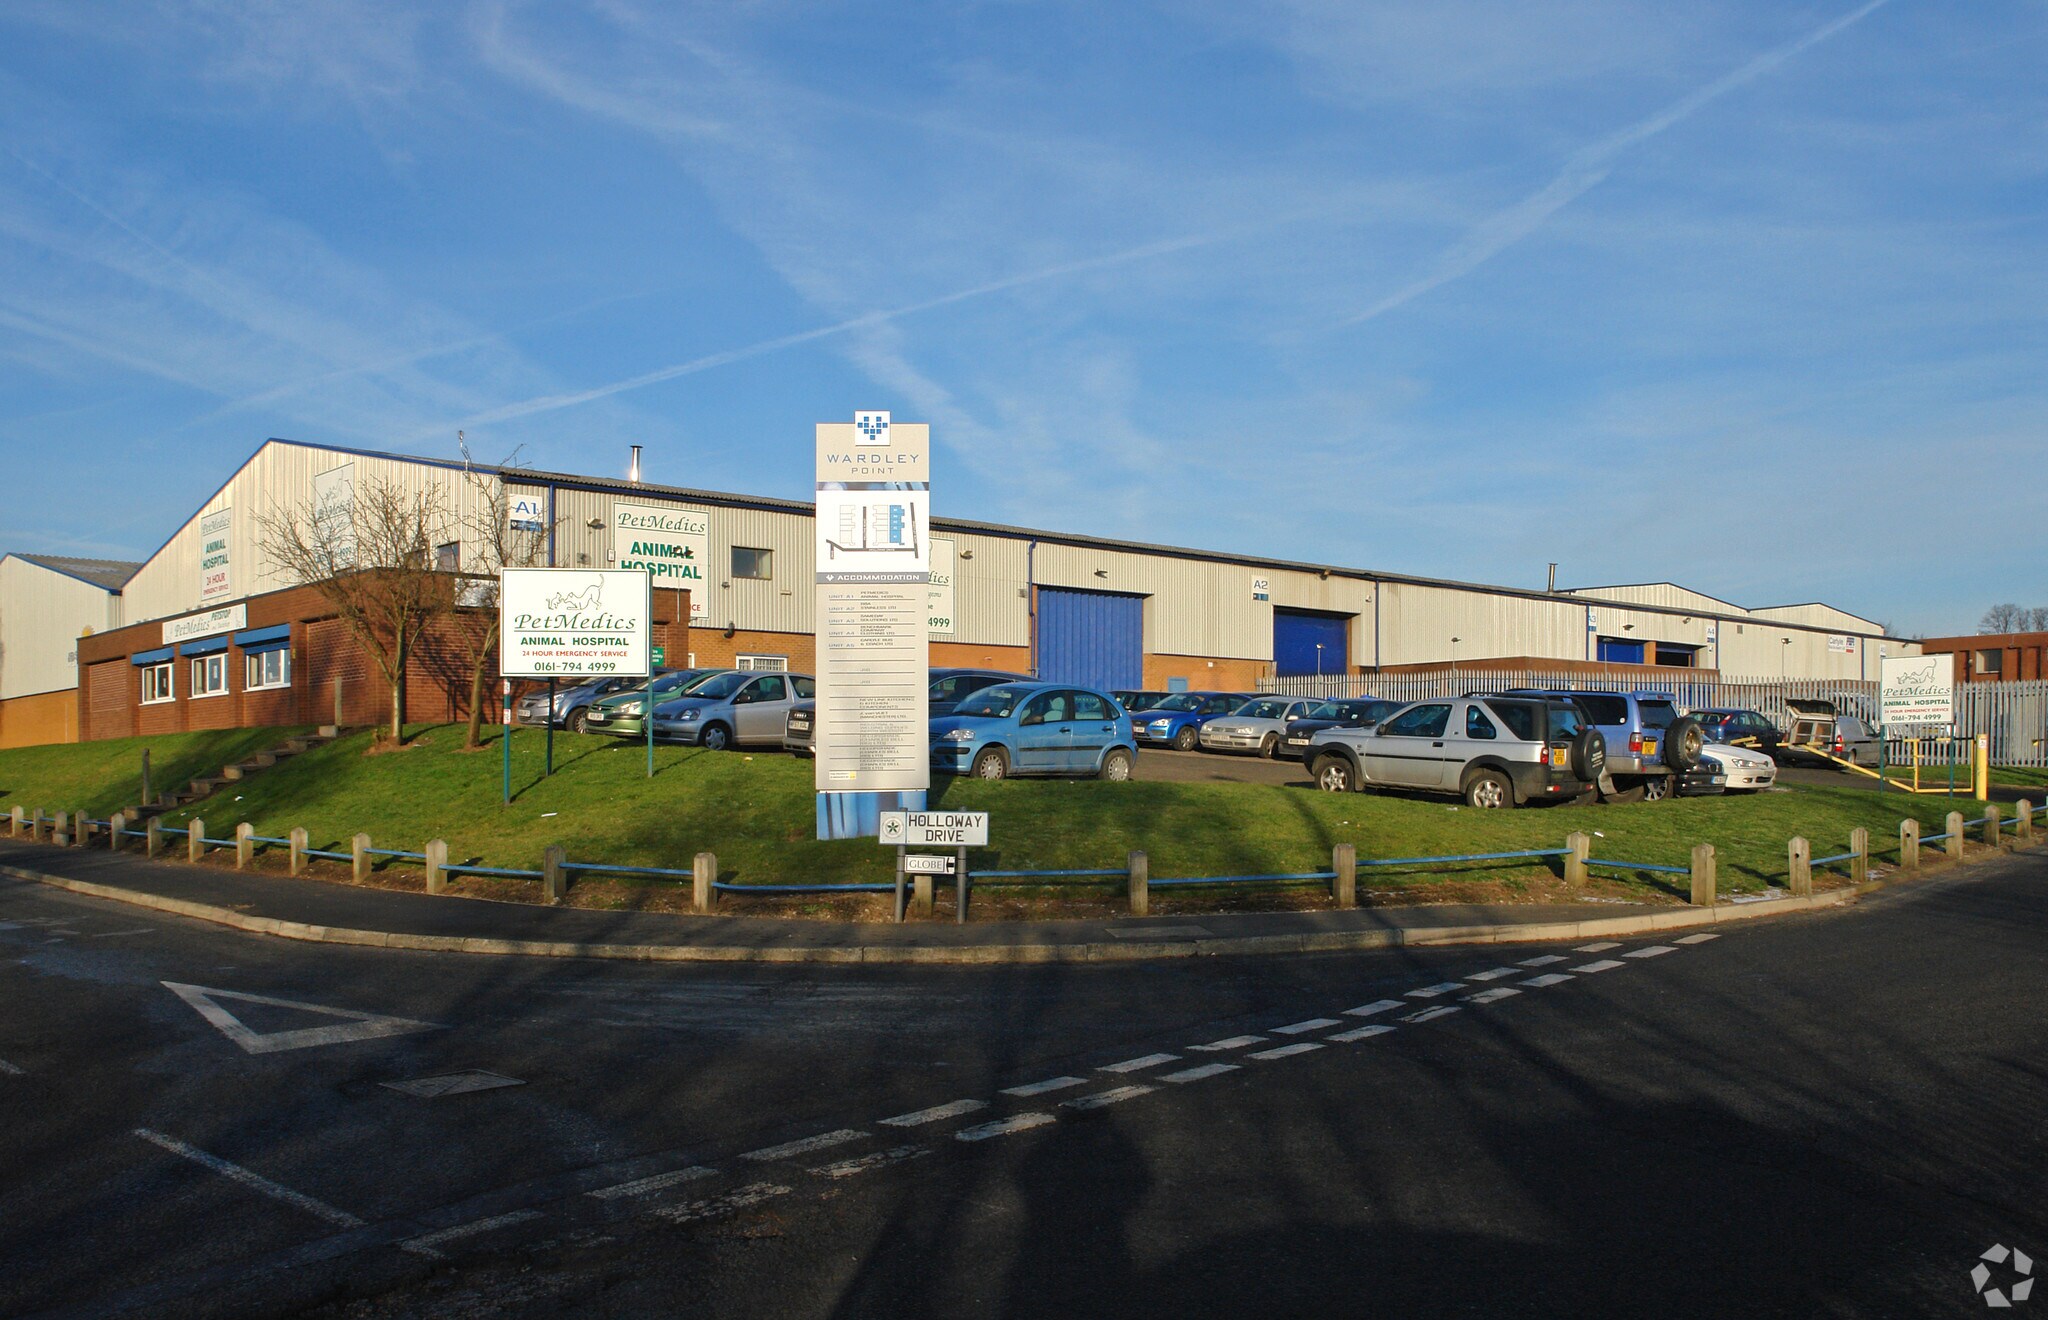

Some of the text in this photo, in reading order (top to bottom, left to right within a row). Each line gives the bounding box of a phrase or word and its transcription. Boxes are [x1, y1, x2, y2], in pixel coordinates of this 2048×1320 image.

[827, 454, 919, 464] WARDLEY
[851, 467, 894, 475] POINT
[515, 501, 537, 515] A1
[618, 512, 705, 533] PetMedics
[205, 538, 226, 555] ANIMAL
[630, 541, 694, 559] ANIMAL
[203, 553, 229, 571] HOSPITAL
[621, 560, 702, 580] HOSPITAL
[206, 572, 226, 586] 24 HOUR
[1253, 579, 1268, 590] A2
[174, 617, 211, 637] PetMedics
[514, 612, 636, 630] PetMedics
[520, 637, 630, 646] ANIMAL HOSPITAL
[534, 662, 616, 672] 0161-794 4999
[1883, 685, 1951, 697] PetMedics
[909, 814, 982, 827] HOLLOWAY
[925, 829, 965, 842] DRIVE
[909, 860, 942, 869] GLOBE
